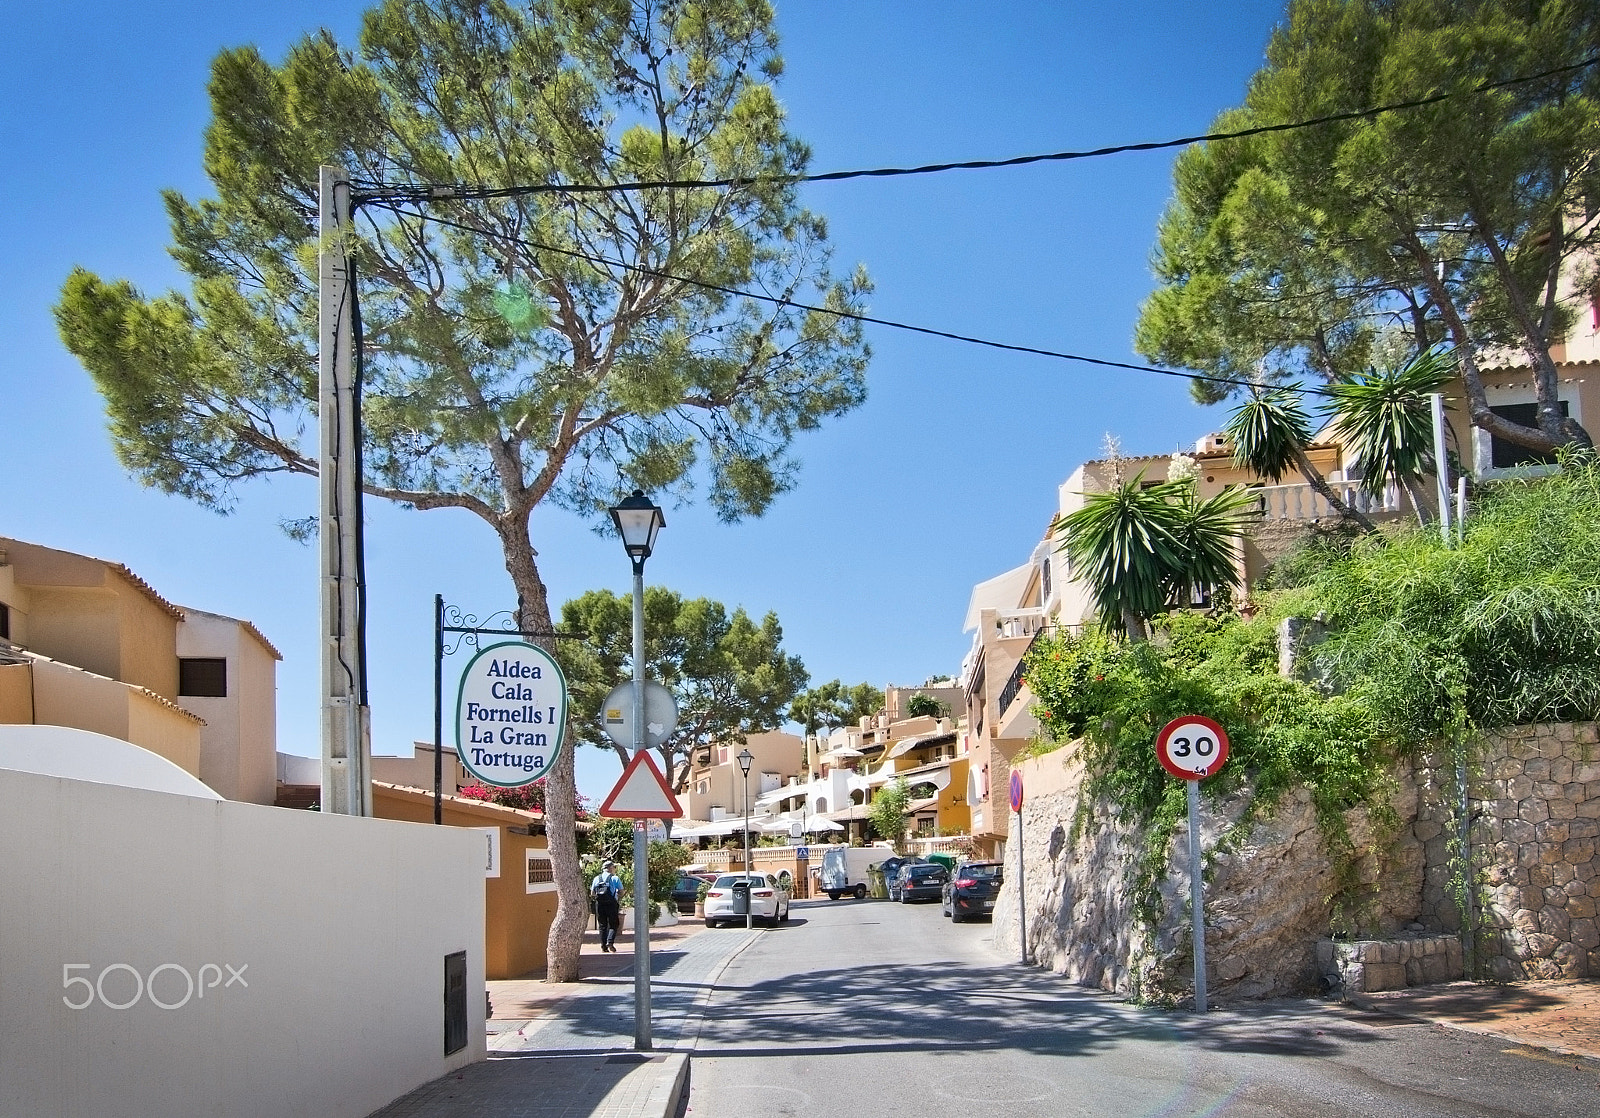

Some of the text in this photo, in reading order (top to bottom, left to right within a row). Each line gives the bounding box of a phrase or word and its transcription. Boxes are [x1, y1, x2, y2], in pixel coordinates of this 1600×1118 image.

[486, 659, 542, 679] Aldea
[491, 681, 533, 701] Cala
[466, 702, 555, 724] Fornells I
[470, 725, 547, 746] La Gran
[1173, 736, 1214, 758] 30
[470, 748, 544, 772] Tortuga
